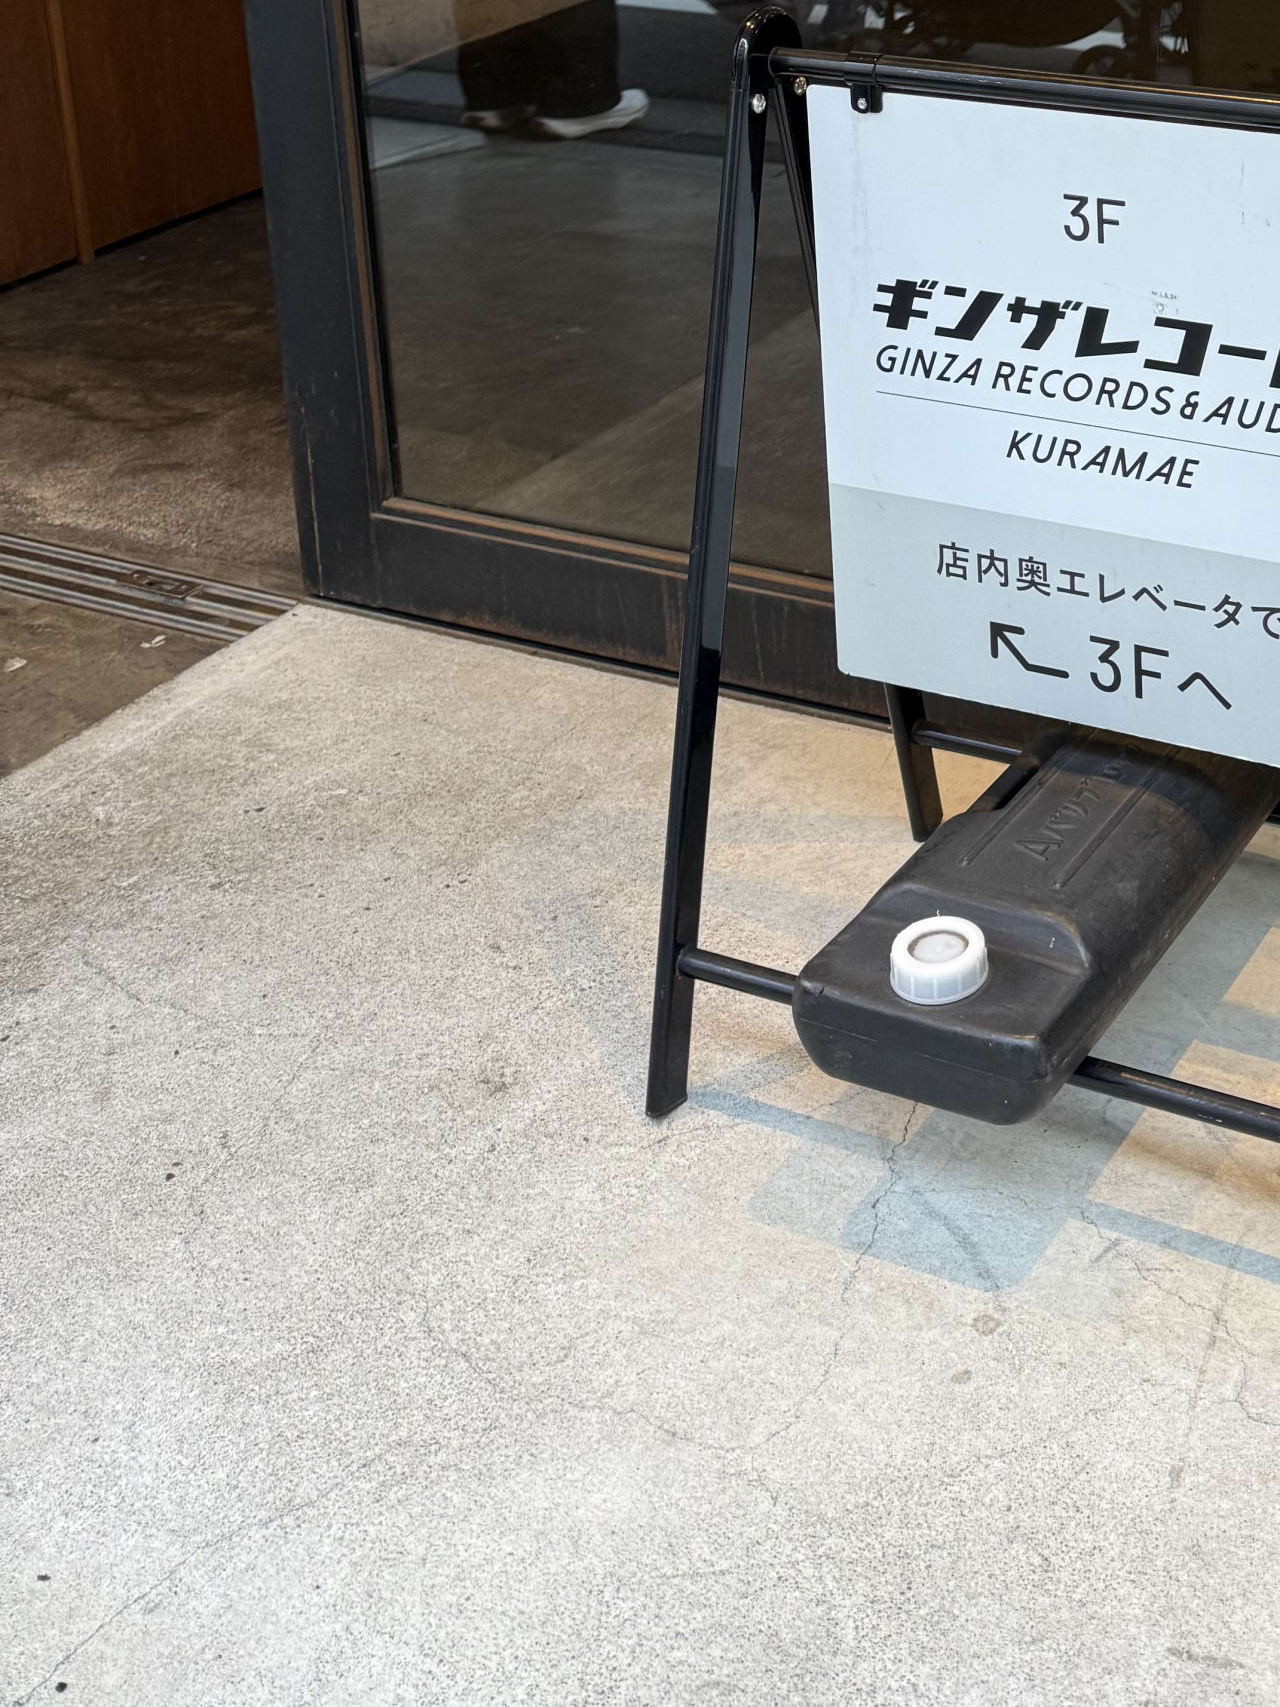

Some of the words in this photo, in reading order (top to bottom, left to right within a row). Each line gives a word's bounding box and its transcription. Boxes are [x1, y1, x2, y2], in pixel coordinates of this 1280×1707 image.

[1062, 193, 1127, 244] 3F
[875, 344, 983, 387] GINZA
[1005, 431, 1201, 490] KURAMAE
[1088, 636, 1233, 711] 3Fへ
